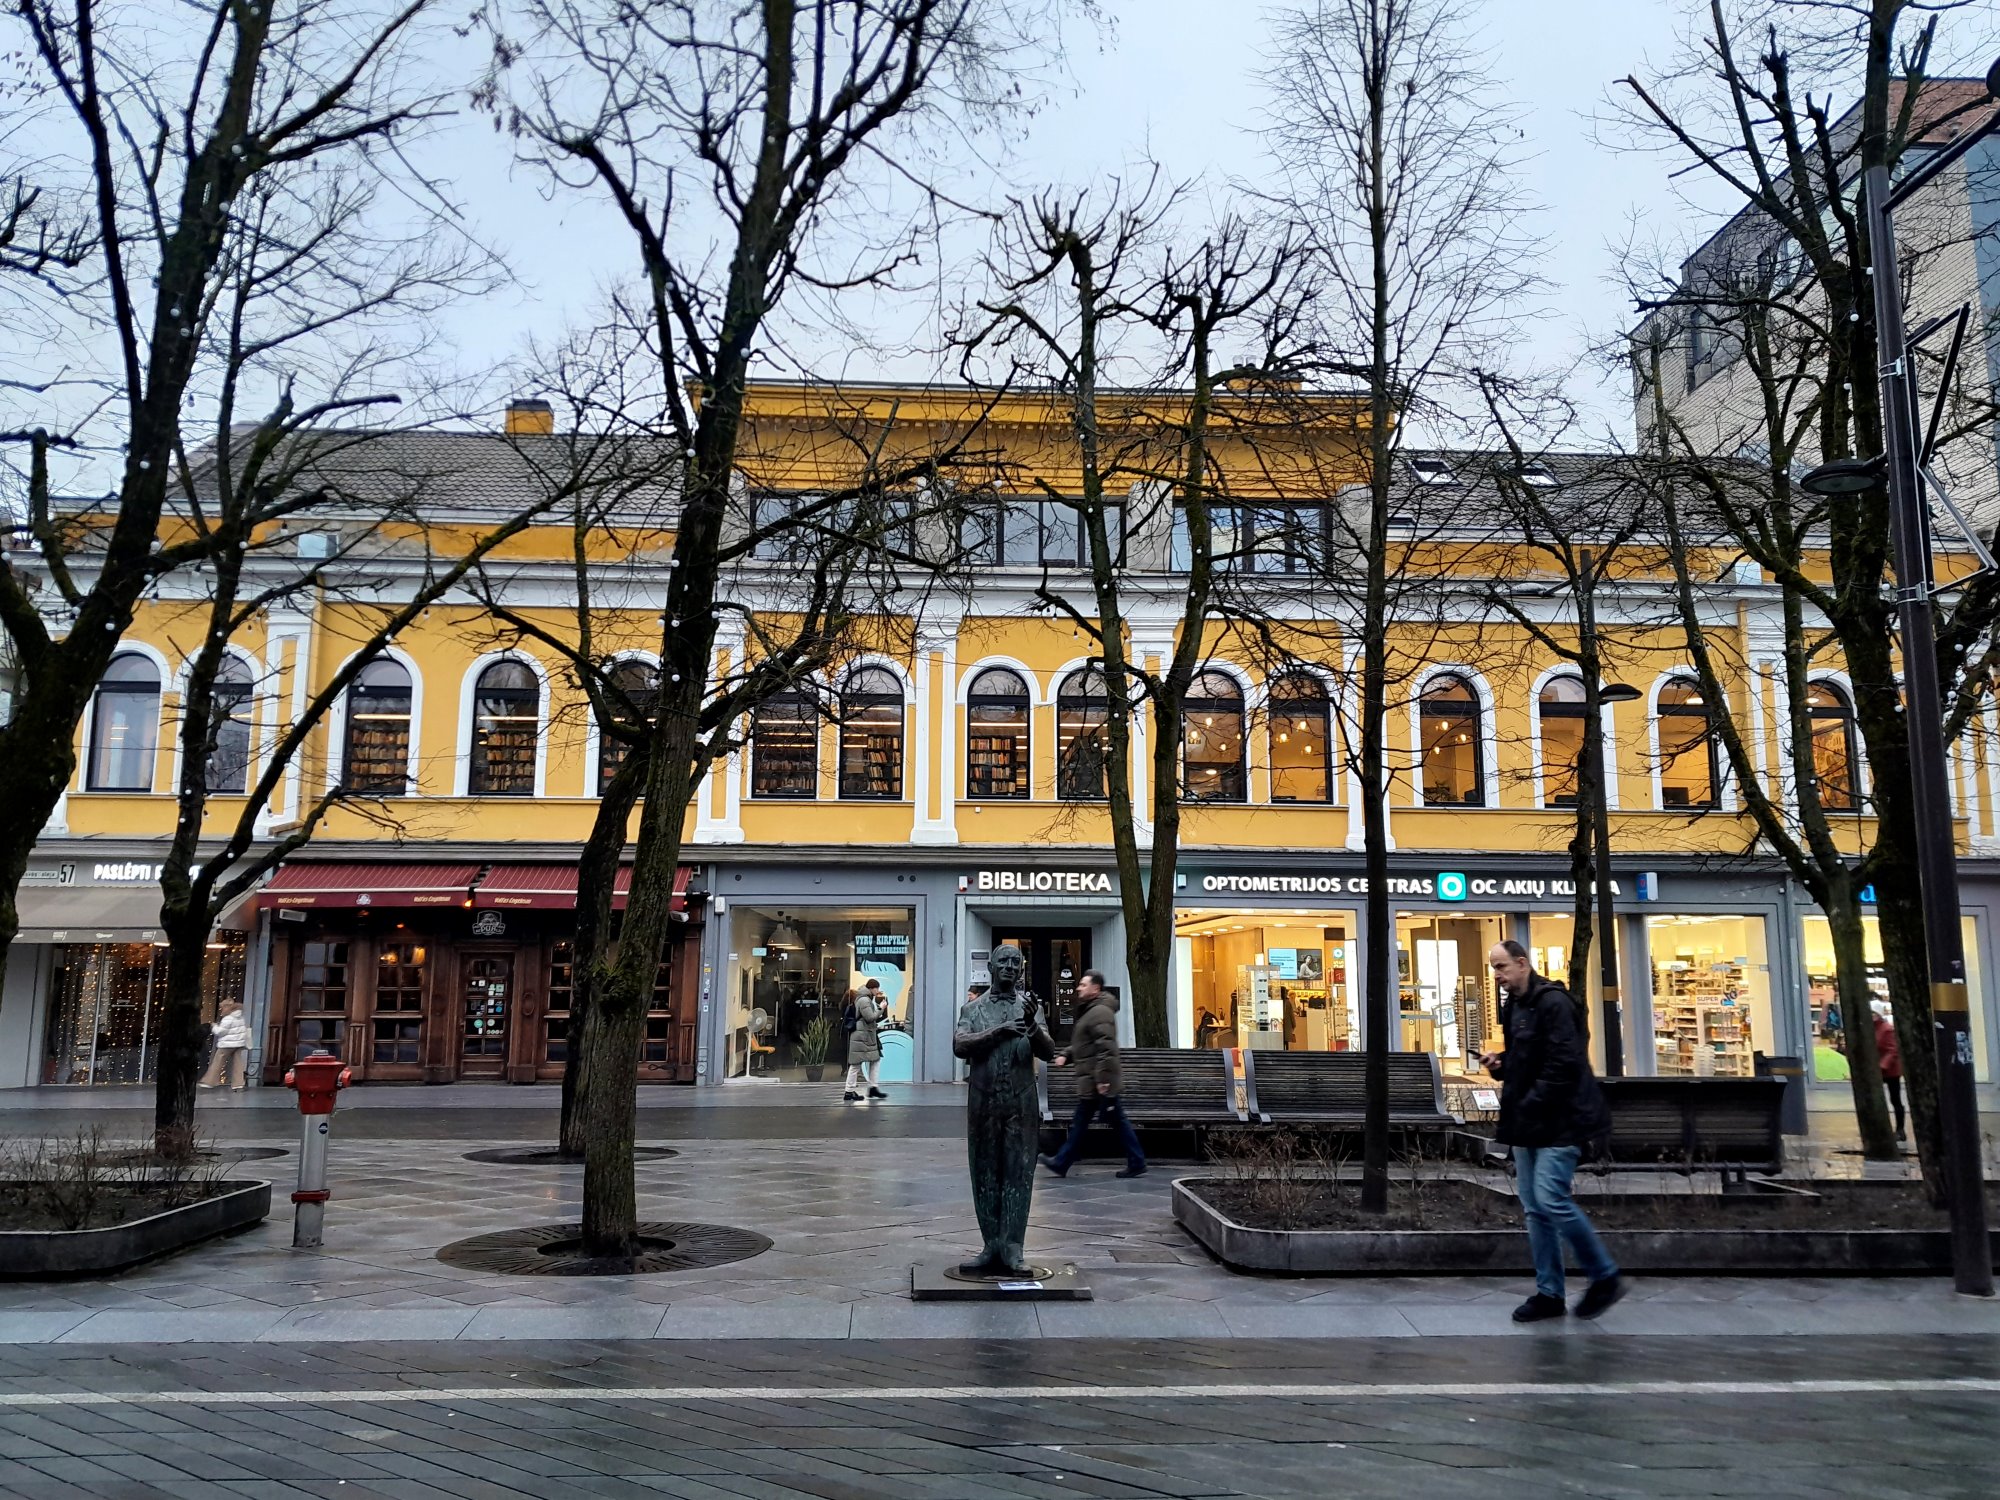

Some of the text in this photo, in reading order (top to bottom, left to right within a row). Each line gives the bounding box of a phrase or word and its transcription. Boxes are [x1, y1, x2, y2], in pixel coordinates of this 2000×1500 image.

[60, 864, 76, 883] 57
[978, 871, 1112, 892] BIBLIOTEKA
[1202, 875, 1433, 894] OPTOMETRIJOS CETRAS
[1471, 879, 1497, 894] OC
[1502, 880, 1545, 898] AKIŲ
[855, 935, 910, 947] VYRŲ KIRPYKLA
